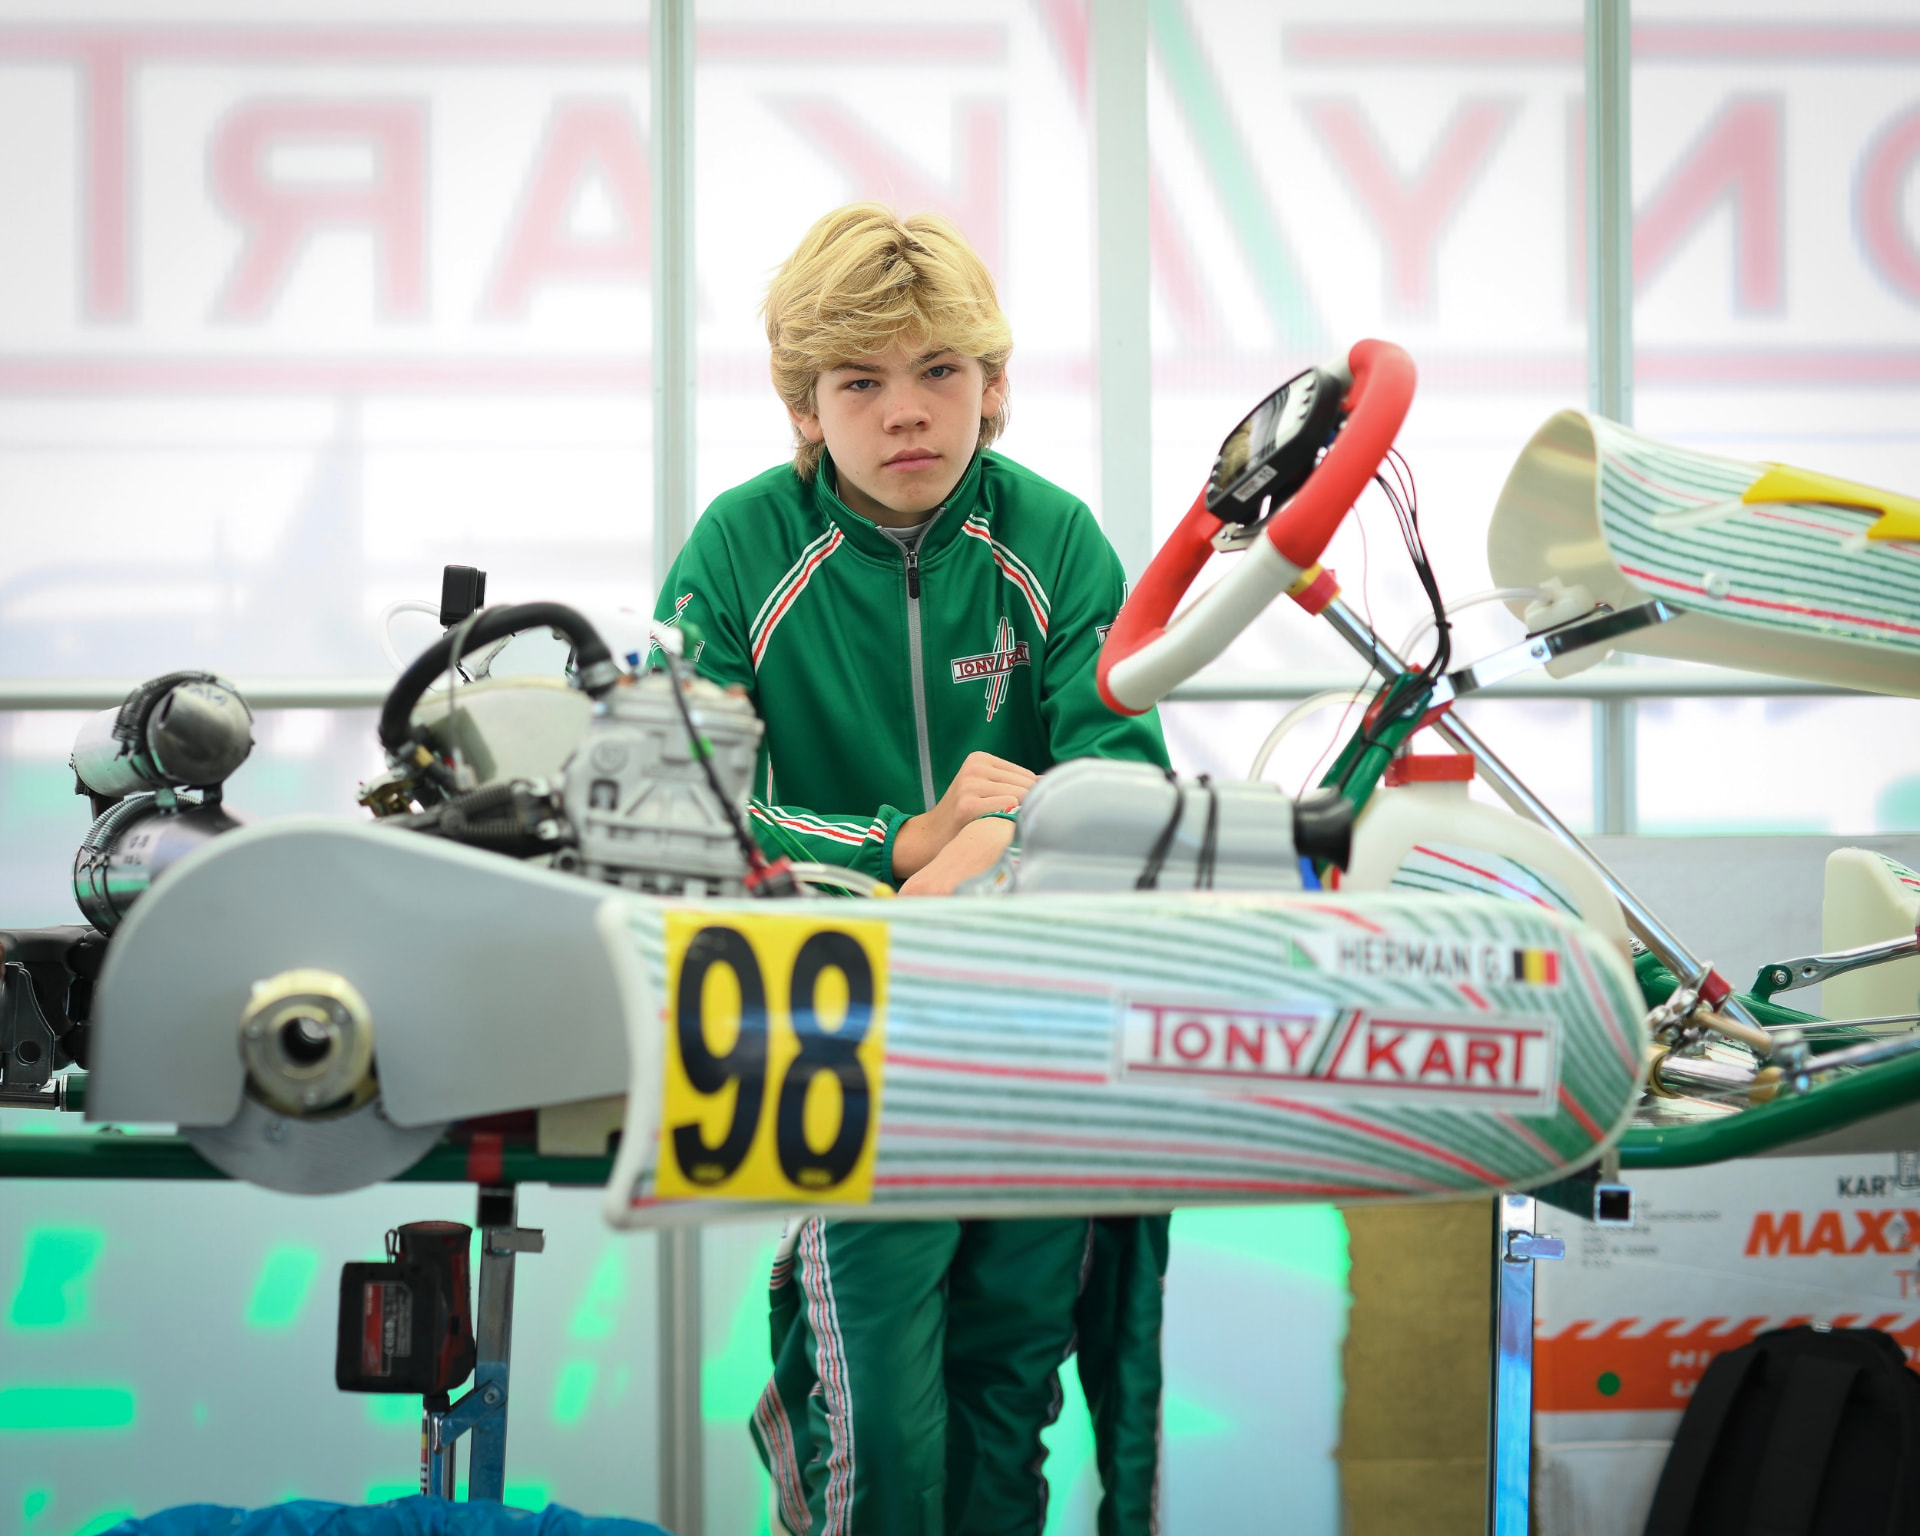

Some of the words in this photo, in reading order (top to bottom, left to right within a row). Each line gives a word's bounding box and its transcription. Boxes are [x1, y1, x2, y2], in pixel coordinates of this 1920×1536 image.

[954, 656, 996, 676] TONY
[1335, 937, 1473, 977] HERMAN
[672, 925, 874, 1191] 98
[1131, 1003, 1316, 1068] TONY
[1367, 1019, 1545, 1085] KART
